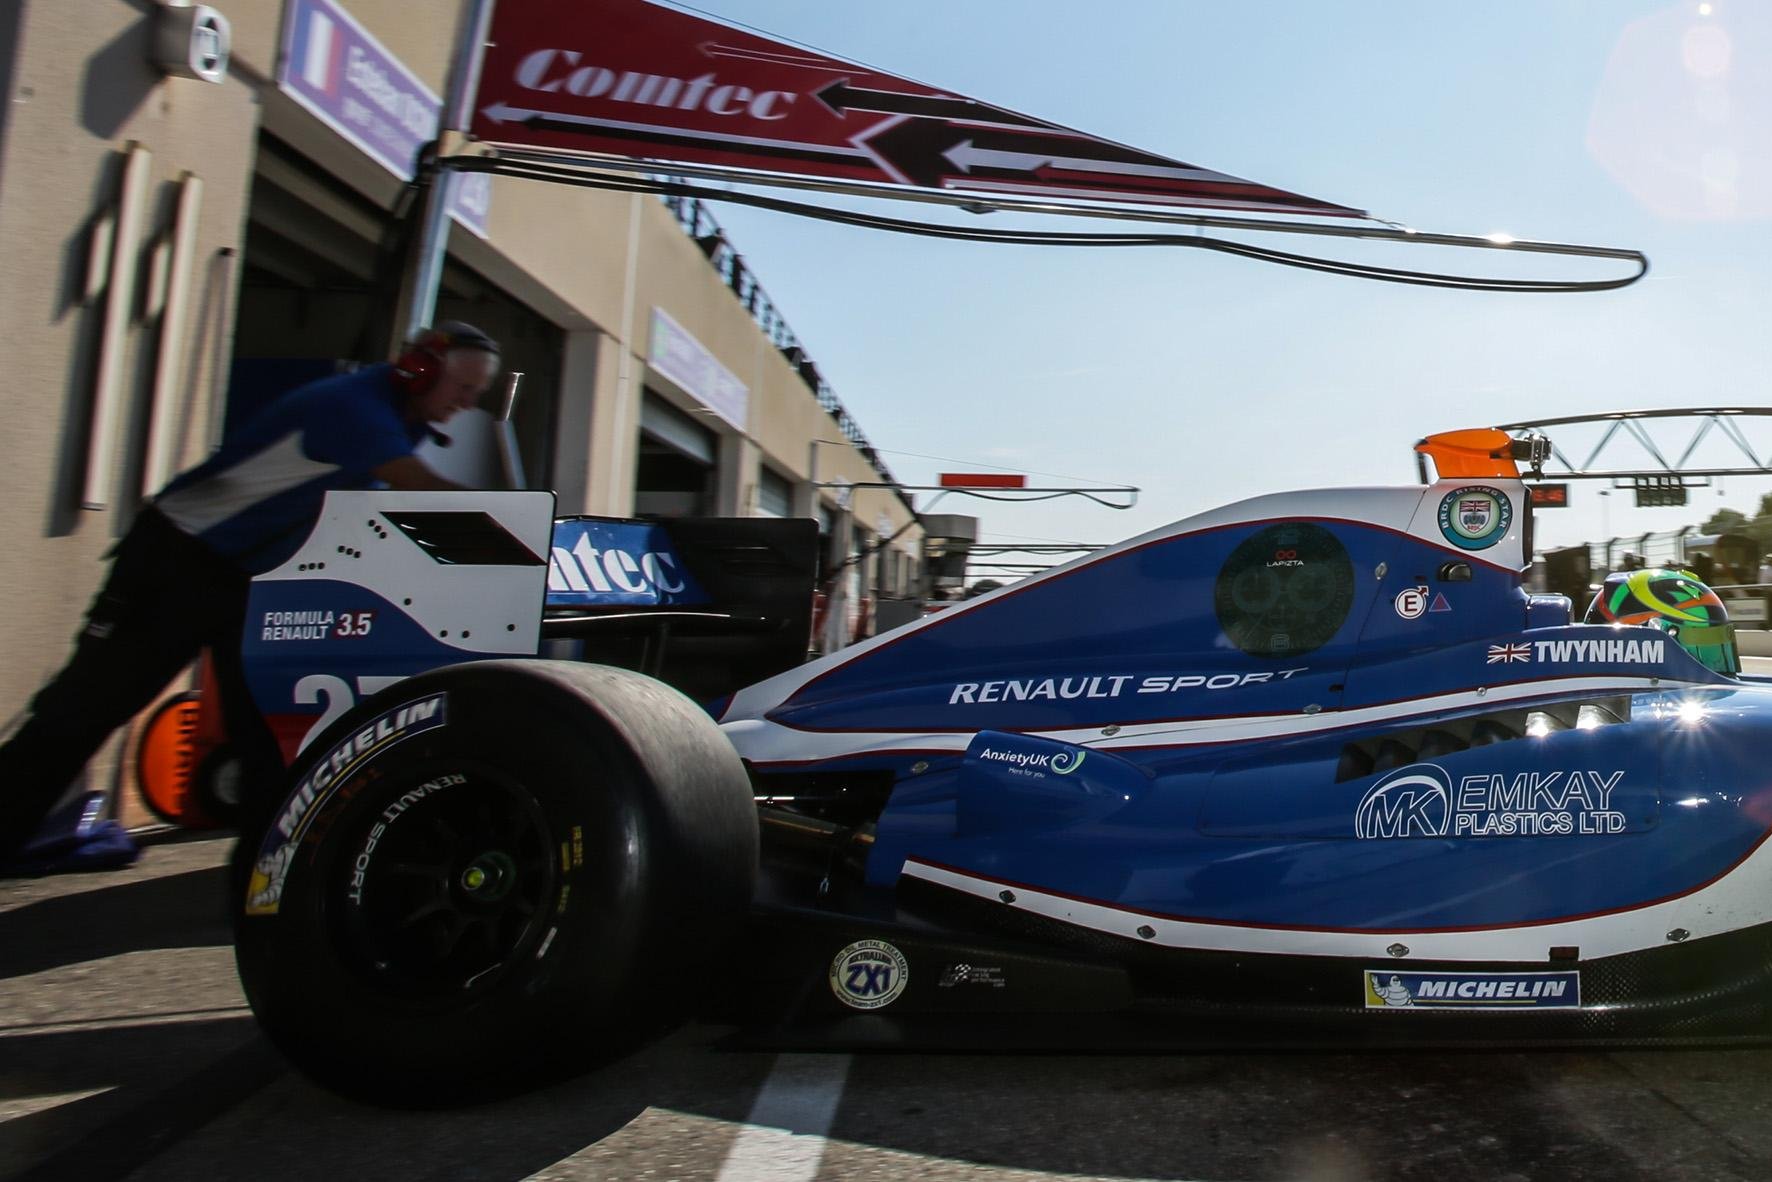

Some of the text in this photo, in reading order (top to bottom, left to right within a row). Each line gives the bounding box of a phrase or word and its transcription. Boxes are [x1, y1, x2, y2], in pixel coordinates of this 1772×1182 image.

[514, 49, 799, 121] Comtec
[1440, 495, 1454, 529] BRDC
[1455, 486, 1499, 496] RISING
[1498, 497, 1510, 528] STAR
[1266, 559, 1305, 568] LAPIZTA
[263, 610, 334, 626] FORMULA
[1403, 593, 1419, 613] E
[261, 625, 329, 641] RENAULT
[336, 612, 373, 637] 3.5
[1535, 639, 1664, 663] TWYNHAM
[949, 667, 1309, 705] RENAULT SPORT
[294, 674, 411, 759] 2
[276, 696, 442, 839] MICHELIN
[980, 748, 1050, 767] AnxietyUK
[382, 772, 467, 824] RENAULT
[1457, 771, 1625, 811] EMKAY
[1455, 811, 1627, 836] PLASTICS LTD
[348, 820, 387, 905] SPORT
[858, 940, 881, 949] METAL
[883, 943, 908, 980] TREATMENT
[846, 963, 893, 997] ZX1
[1417, 979, 1567, 999] MICHELIN
